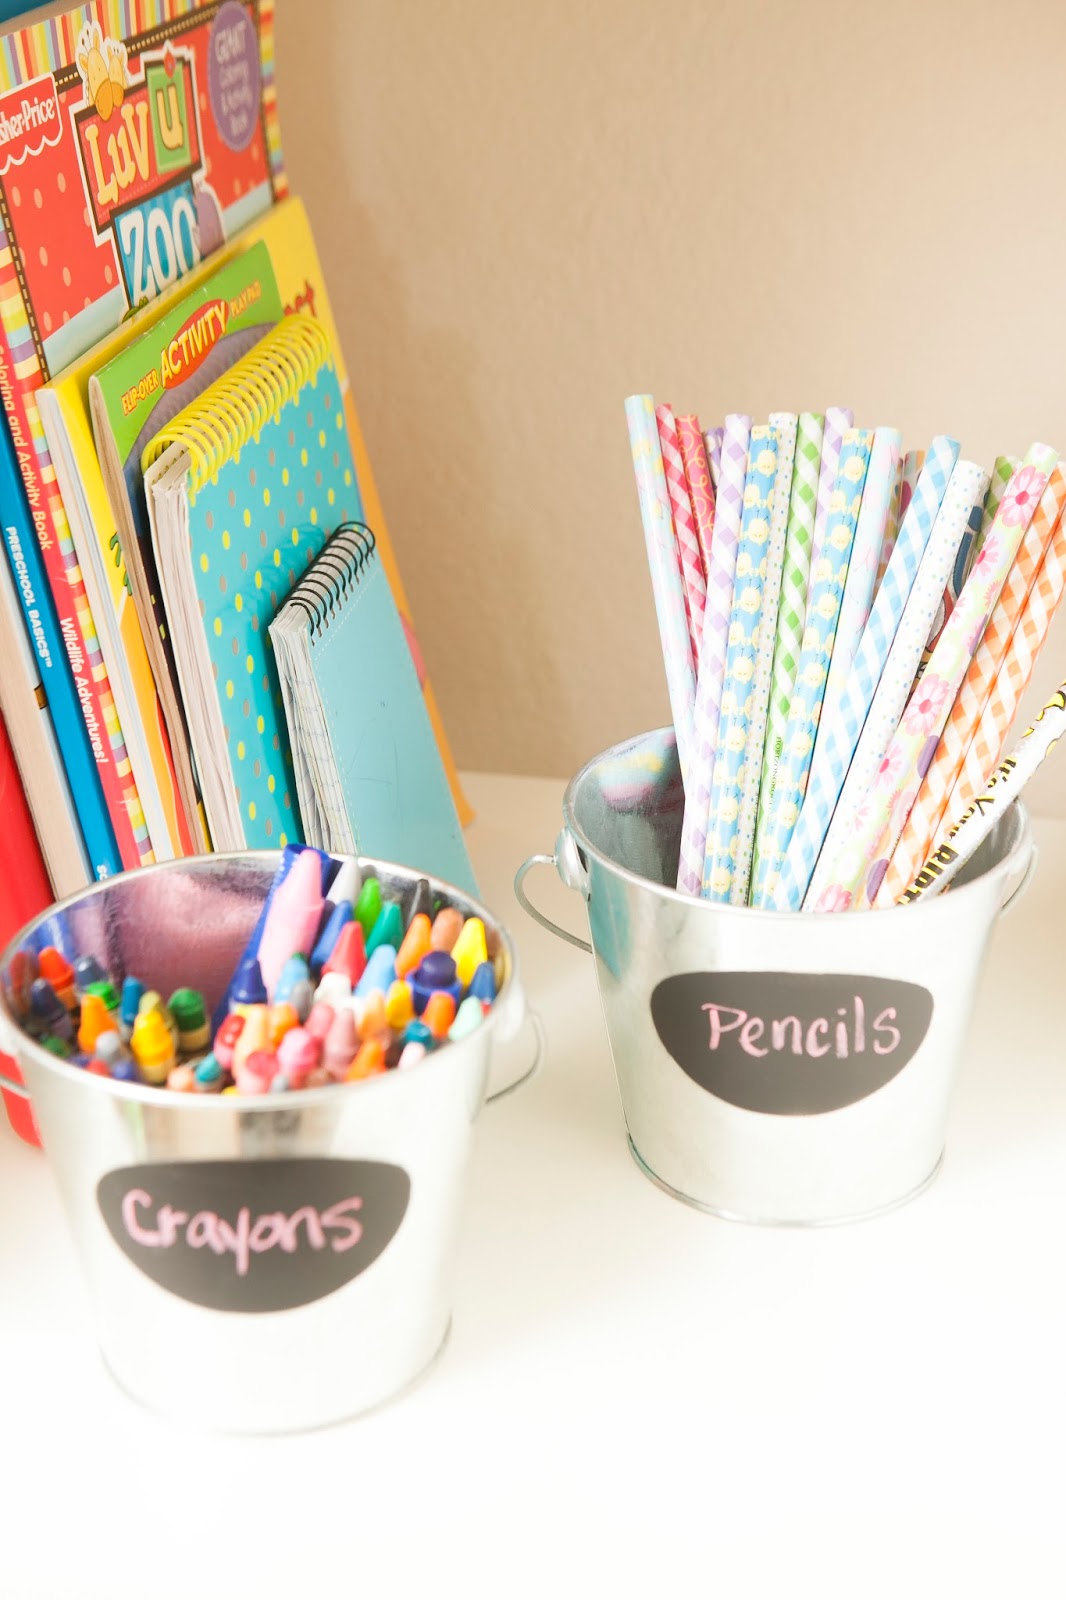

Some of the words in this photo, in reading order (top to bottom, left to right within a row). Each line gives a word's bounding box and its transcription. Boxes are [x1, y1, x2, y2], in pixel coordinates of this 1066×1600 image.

[121, 368, 160, 416] FLIP-OVER
[160, 300, 228, 389] ACTIVITY
[8, 416, 29, 447] and
[17, 451, 41, 507] Activity
[5, 526, 36, 607] PRESCHOOL
[32, 511, 54, 550] Book
[61, 617, 85, 673] Wildlife
[74, 676, 109, 763] Adventures!
[701, 995, 901, 1059] Pencils
[121, 1188, 363, 1277] Crayons
